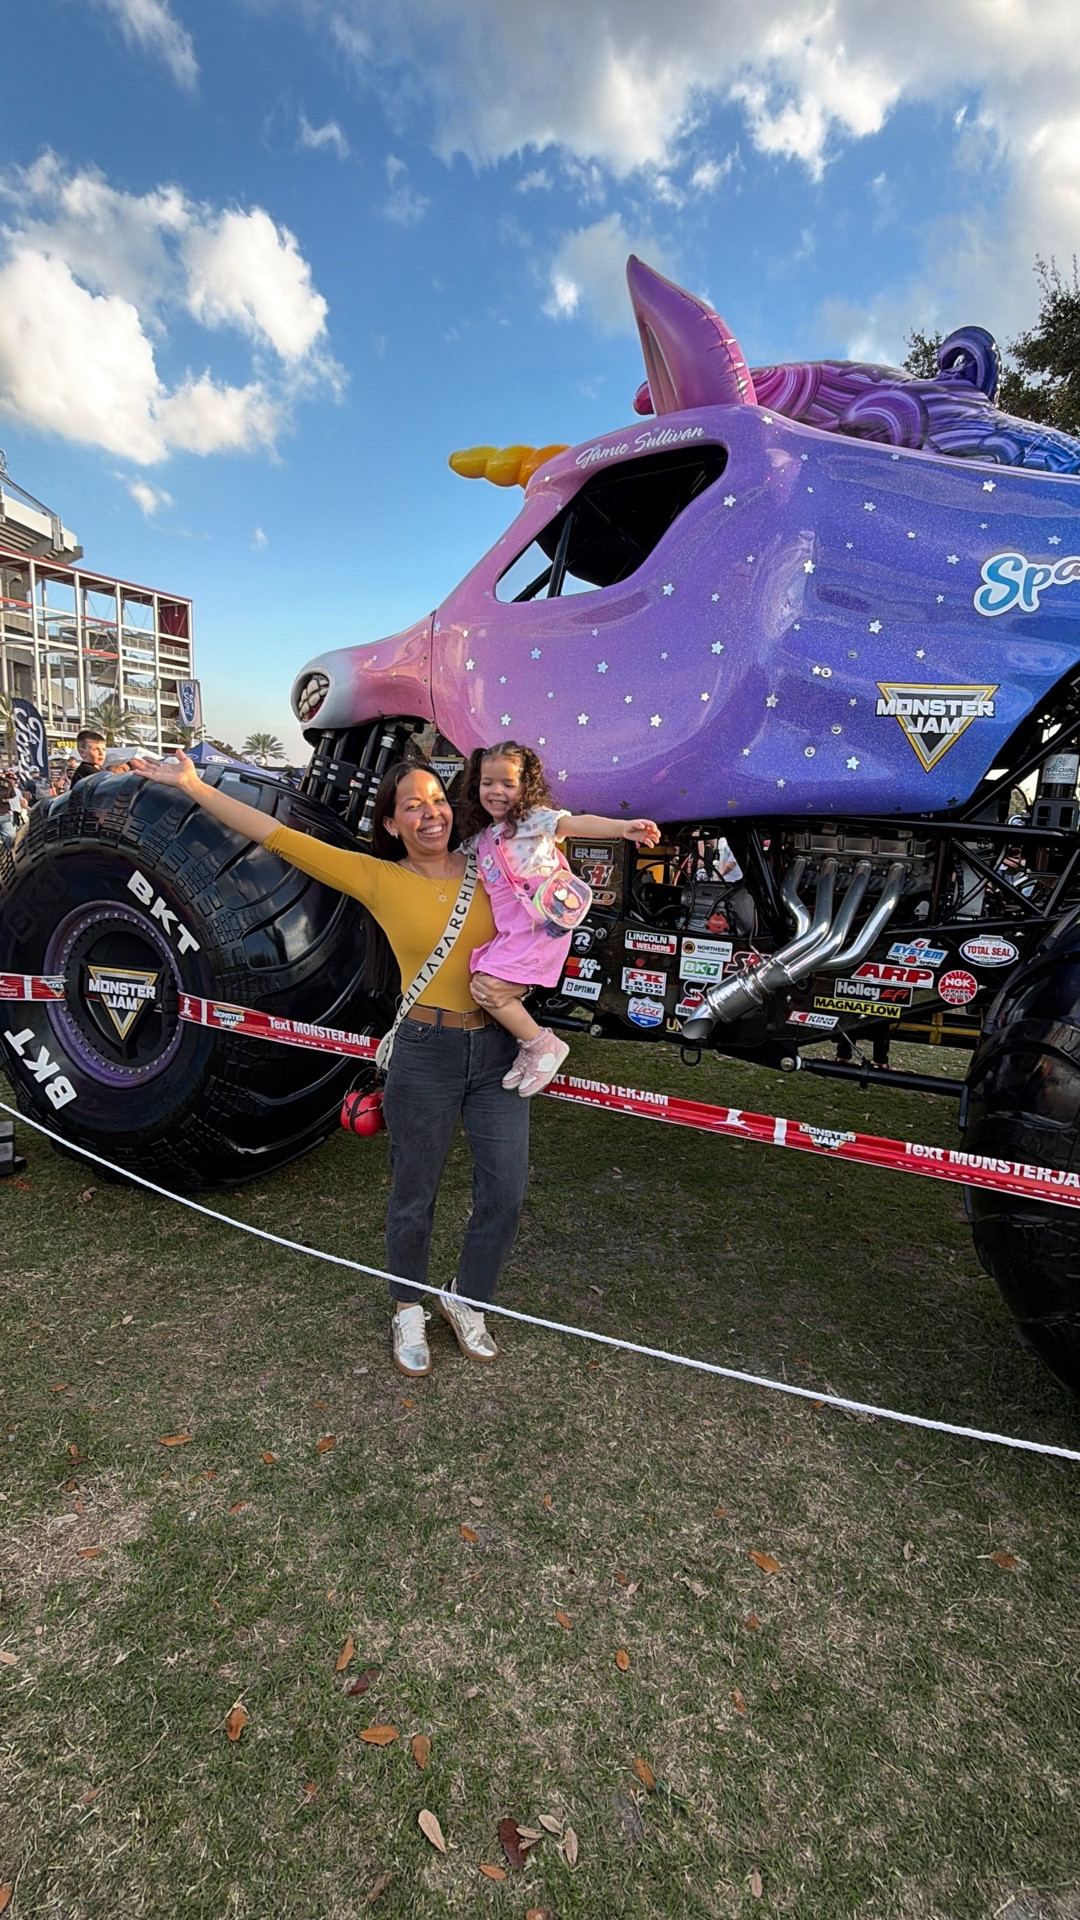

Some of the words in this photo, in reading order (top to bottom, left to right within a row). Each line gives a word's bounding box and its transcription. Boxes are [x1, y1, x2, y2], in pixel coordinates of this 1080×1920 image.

[633, 426, 704, 453] Sullivan
[183, 691, 195, 717] Ford
[876, 698, 995, 717] MONSTER
[907, 716, 962, 734] JAM
[14, 707, 44, 782] Ford
[127, 869, 200, 955] BKT
[628, 931, 667, 944] LINCOLN
[635, 942, 671, 953] WELDERS
[697, 945, 730, 953] NORTHERN
[892, 945, 945, 960] SYSTEM
[967, 945, 990, 956] TOTAL
[991, 947, 1011, 957] SEAL
[684, 961, 720, 976] BKT
[855, 963, 933, 983] ARP
[629, 971, 664, 984] FK
[633, 981, 663, 989] ROD
[945, 977, 971, 988] NGK
[88, 978, 156, 999] MONSTER
[574, 984, 596, 995] OPTIMA
[625, 985, 663, 995] ENDS
[837, 981, 880, 1000] Holley
[107, 995, 138, 1011] JAM
[634, 1005, 661, 1016] LUCAS
[815, 998, 900, 1016] MAGNAFLOW
[212, 1010, 245, 1022] MONSTER
[221, 1019, 238, 1028] JAM
[807, 1014, 836, 1025] KING
[268, 1016, 293, 1031] Text
[293, 1021, 371, 1047] MONSTERJAM
[4, 1028, 77, 1110] BKT
[799, 1123, 856, 1142] MONSTER
[813, 1136, 840, 1148] JAM
[905, 1142, 944, 1161] Text
